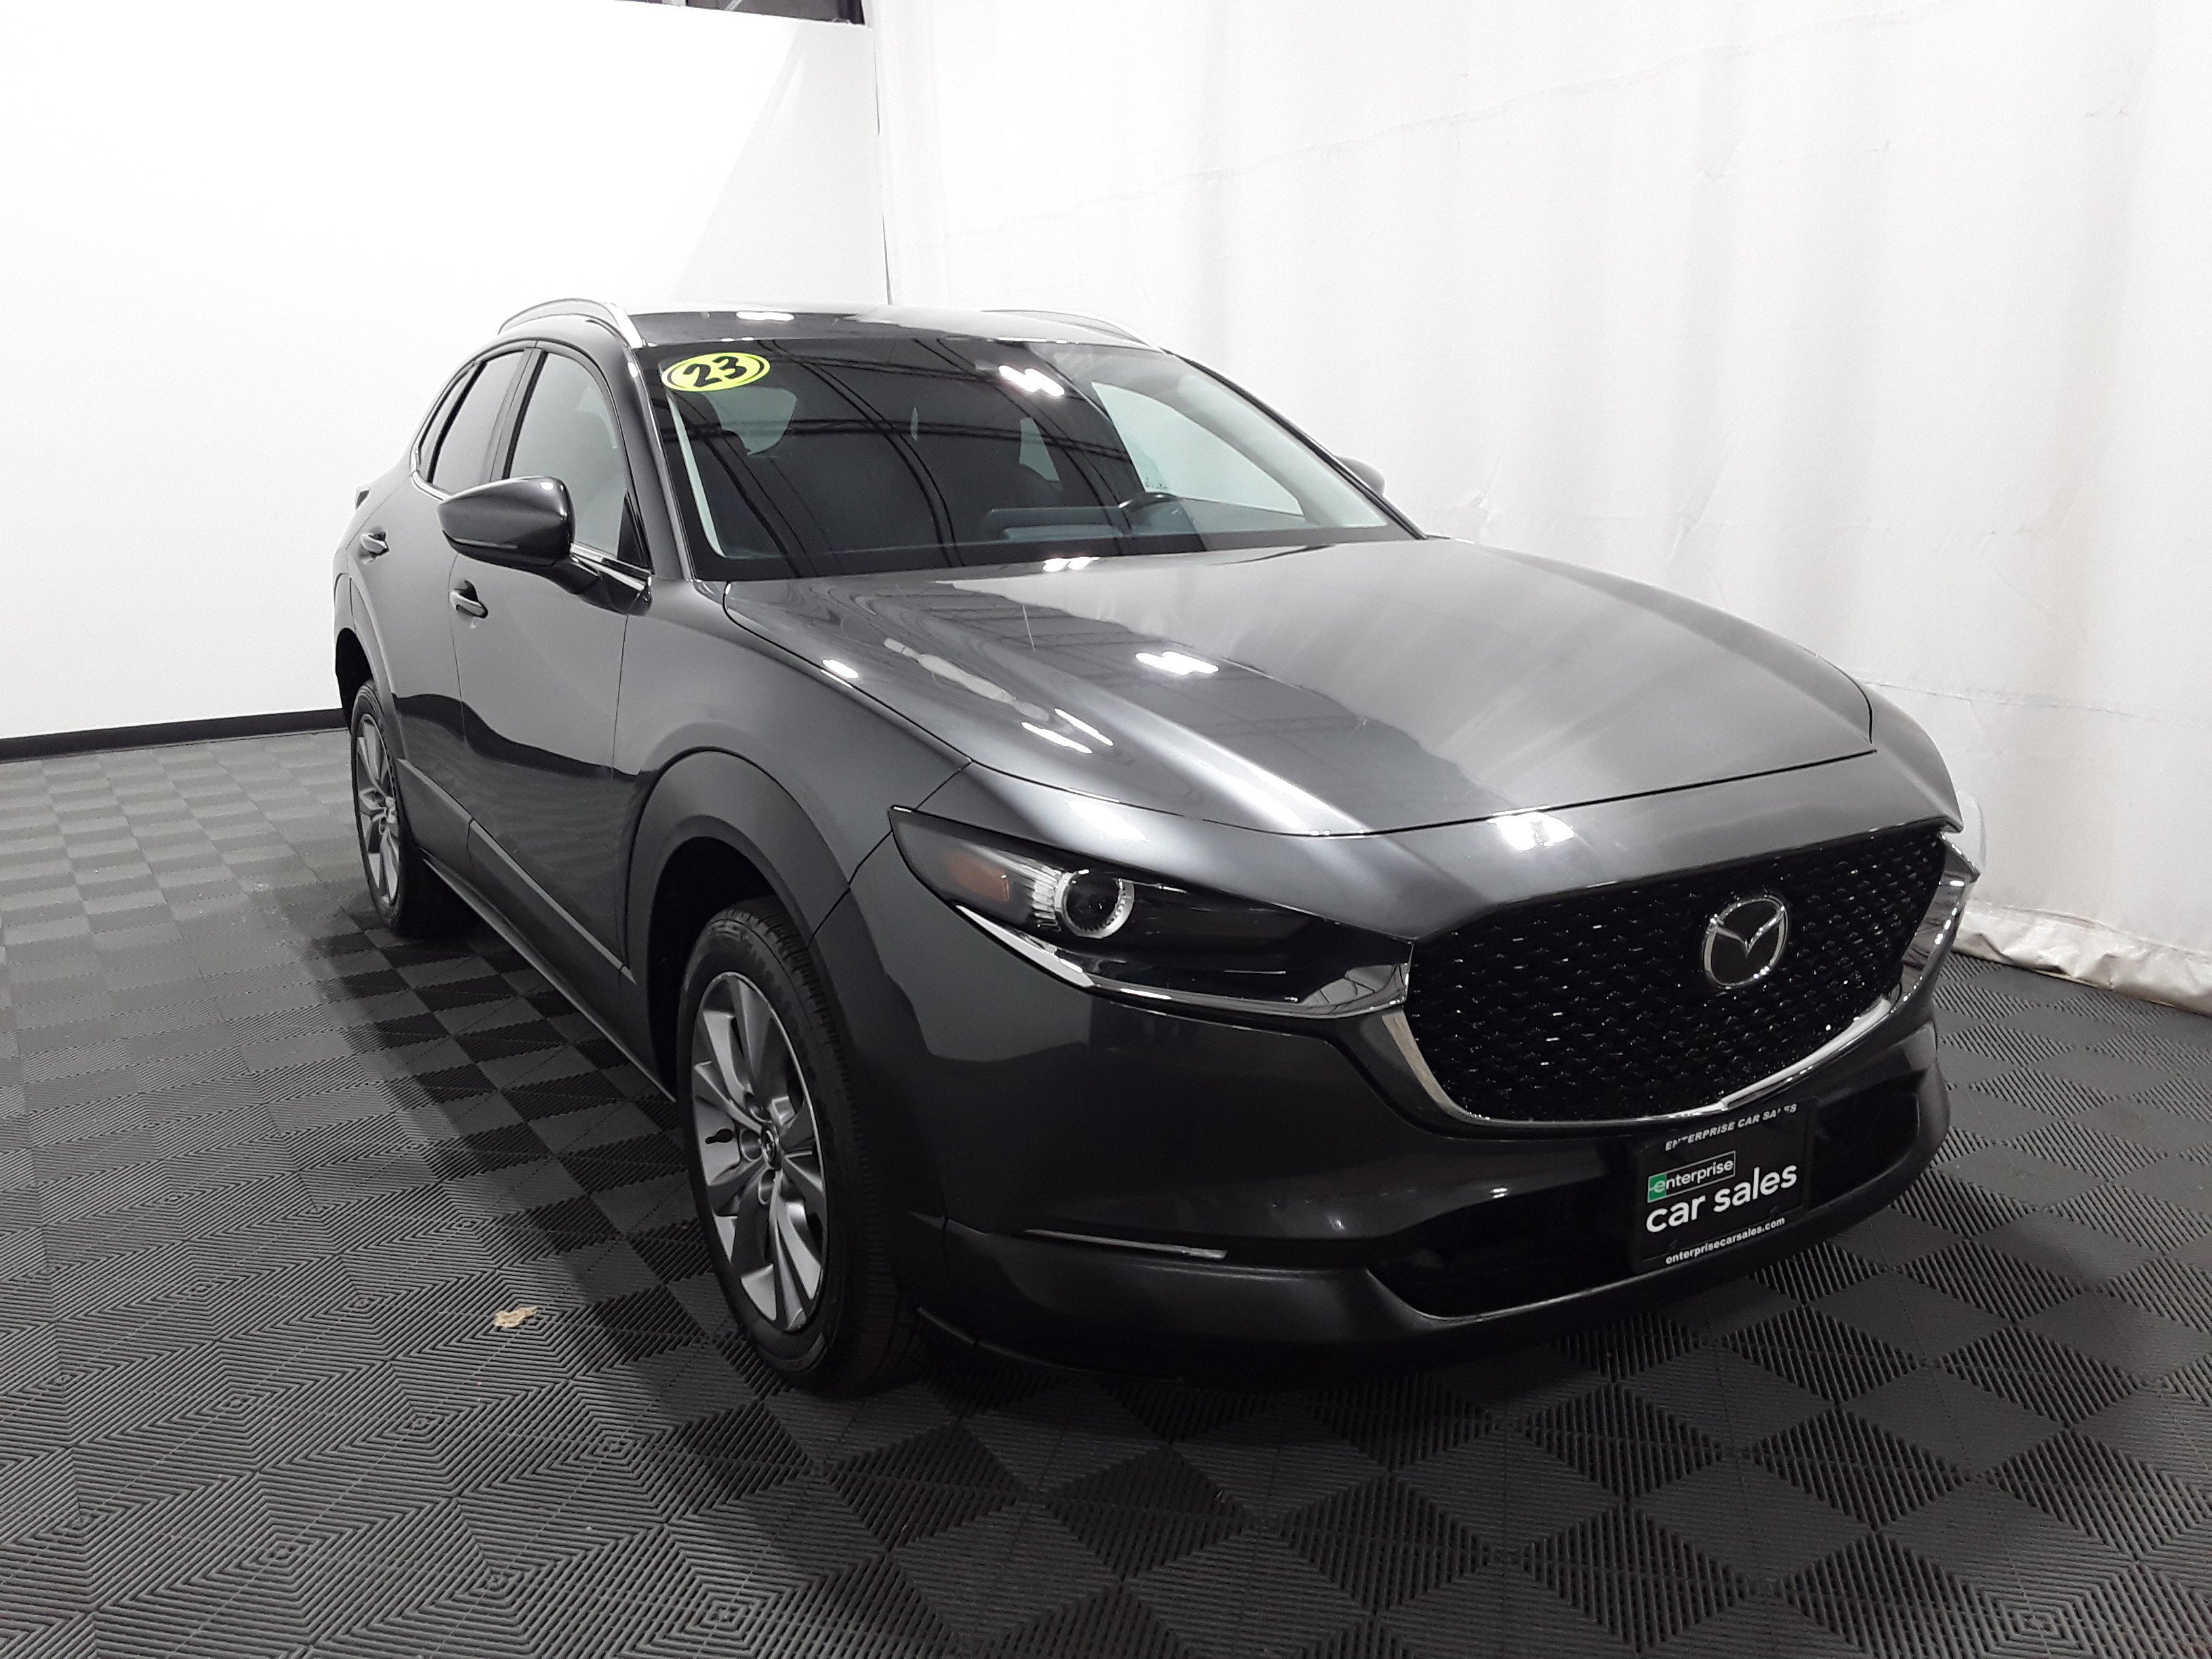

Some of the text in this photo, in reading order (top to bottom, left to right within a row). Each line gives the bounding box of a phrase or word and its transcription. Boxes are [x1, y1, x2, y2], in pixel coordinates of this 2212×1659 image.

[682, 356, 747, 388] 23
[1737, 1113, 1760, 1128] CAR
[1650, 1159, 1734, 1194] enterprise
[1645, 1165, 1797, 1233] car sales
[1665, 1217, 1785, 1265] enterprisecarsales.com
